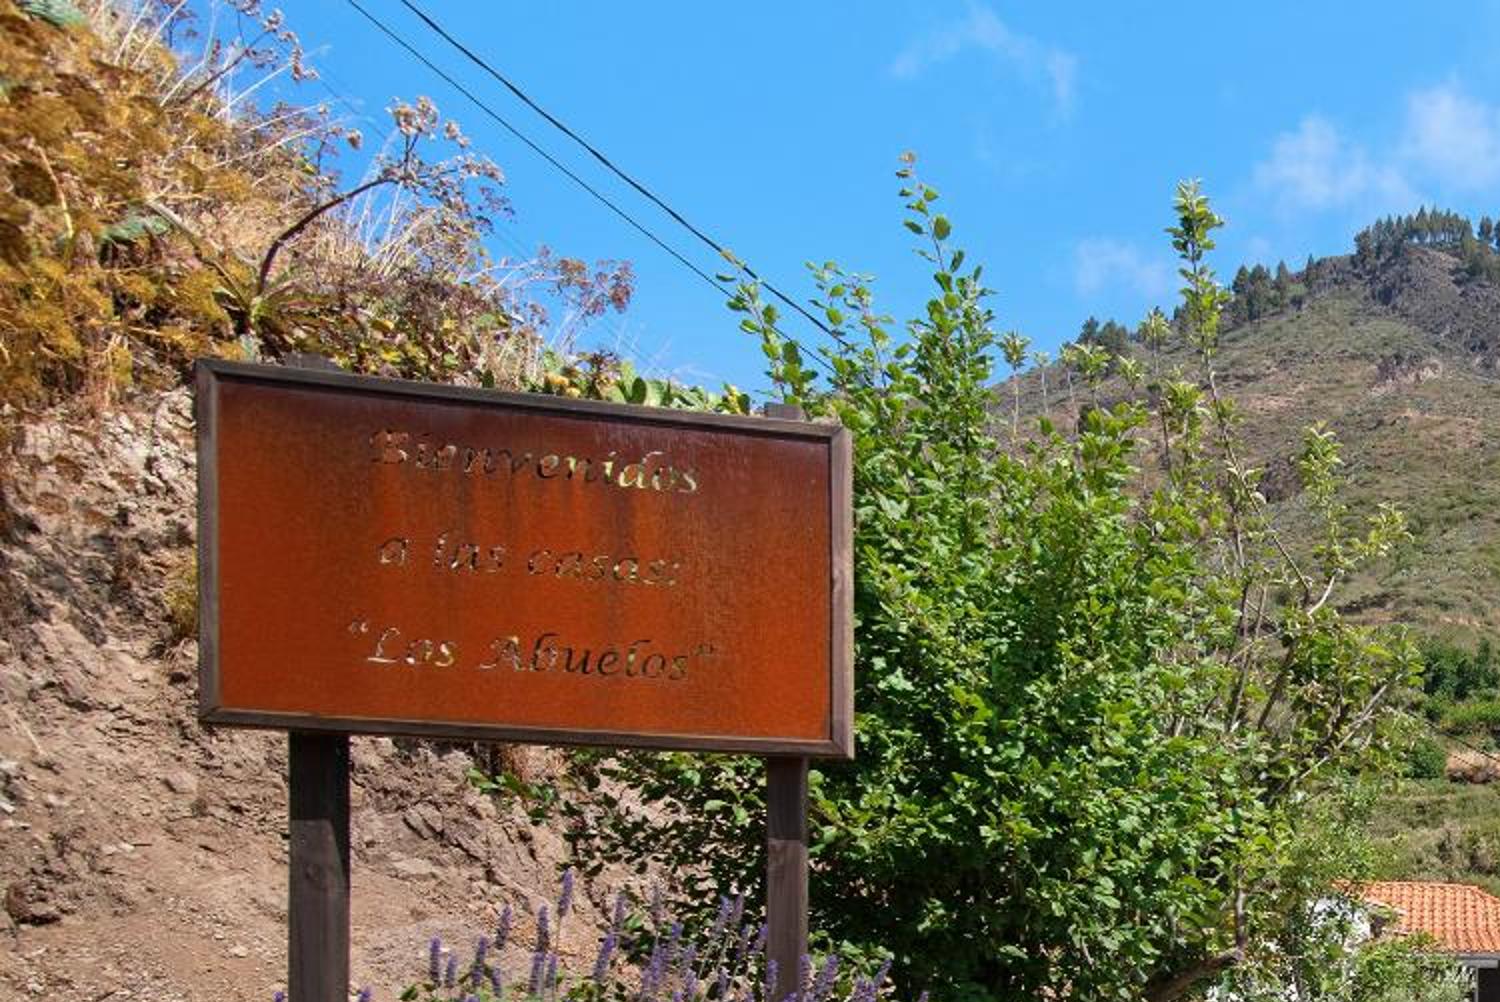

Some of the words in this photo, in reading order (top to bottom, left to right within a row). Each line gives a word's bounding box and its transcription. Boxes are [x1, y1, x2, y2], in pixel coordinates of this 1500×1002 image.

[368, 428, 698, 493] Bienvenidos
[379, 536, 411, 565] a
[431, 529, 507, 574] las
